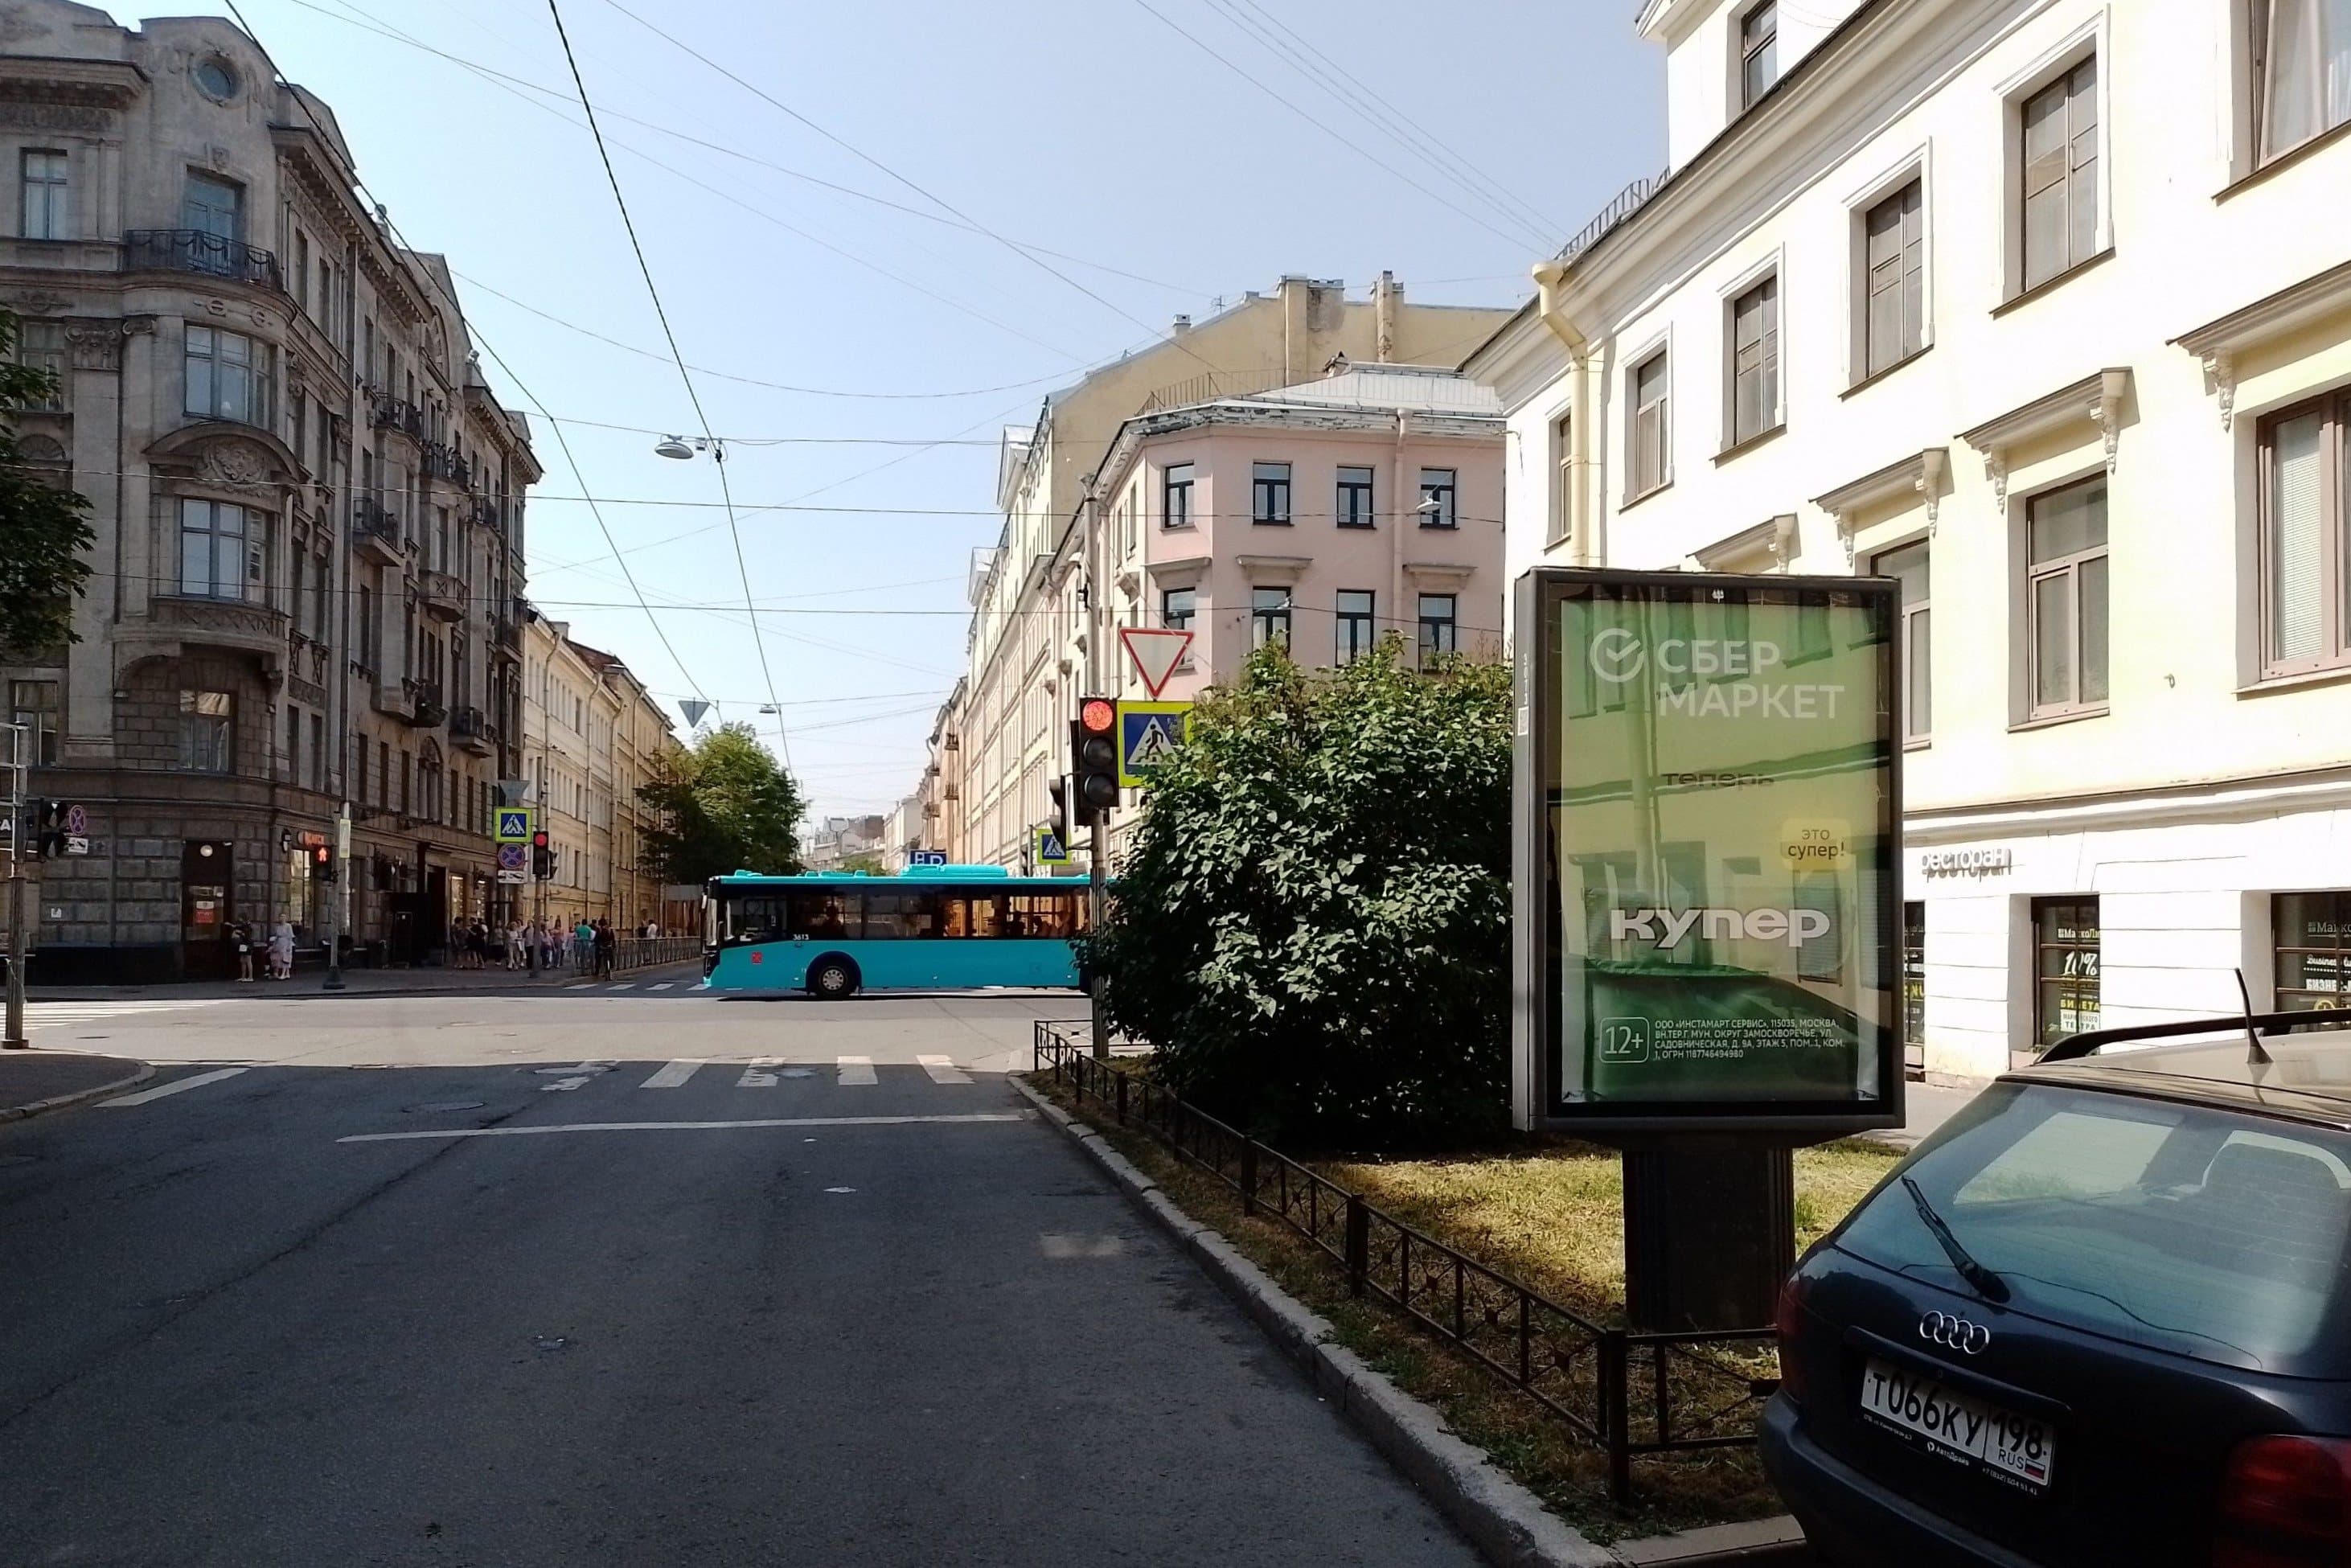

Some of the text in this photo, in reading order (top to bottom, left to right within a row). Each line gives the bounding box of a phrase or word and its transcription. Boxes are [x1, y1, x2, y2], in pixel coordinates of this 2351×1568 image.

[1657, 639, 1780, 675] СБЕР
[1659, 682, 1845, 718] МАРКЕТ
[1661, 773, 1775, 790] теперь
[1788, 843, 1844, 860] супер!
[1921, 848, 2012, 875] ресторан
[1610, 909, 1831, 948] купер
[2060, 999, 2100, 1011] БИЕТА
[1655, 1020, 1674, 1029] ООО
[2065, 1021, 2096, 1030] ТЕТРА
[1605, 1025, 1644, 1054] 12+
[1714, 1030, 1742, 1039] ОКРУГ
[1756, 1039, 1779, 1048] ЭТАЖ
[1662, 1050, 1684, 1059] ОГРН
[1872, 1372, 1984, 1447] Т066КУ
[1991, 1411, 2044, 1459] 198
[1998, 1448, 2025, 1470] RUS
